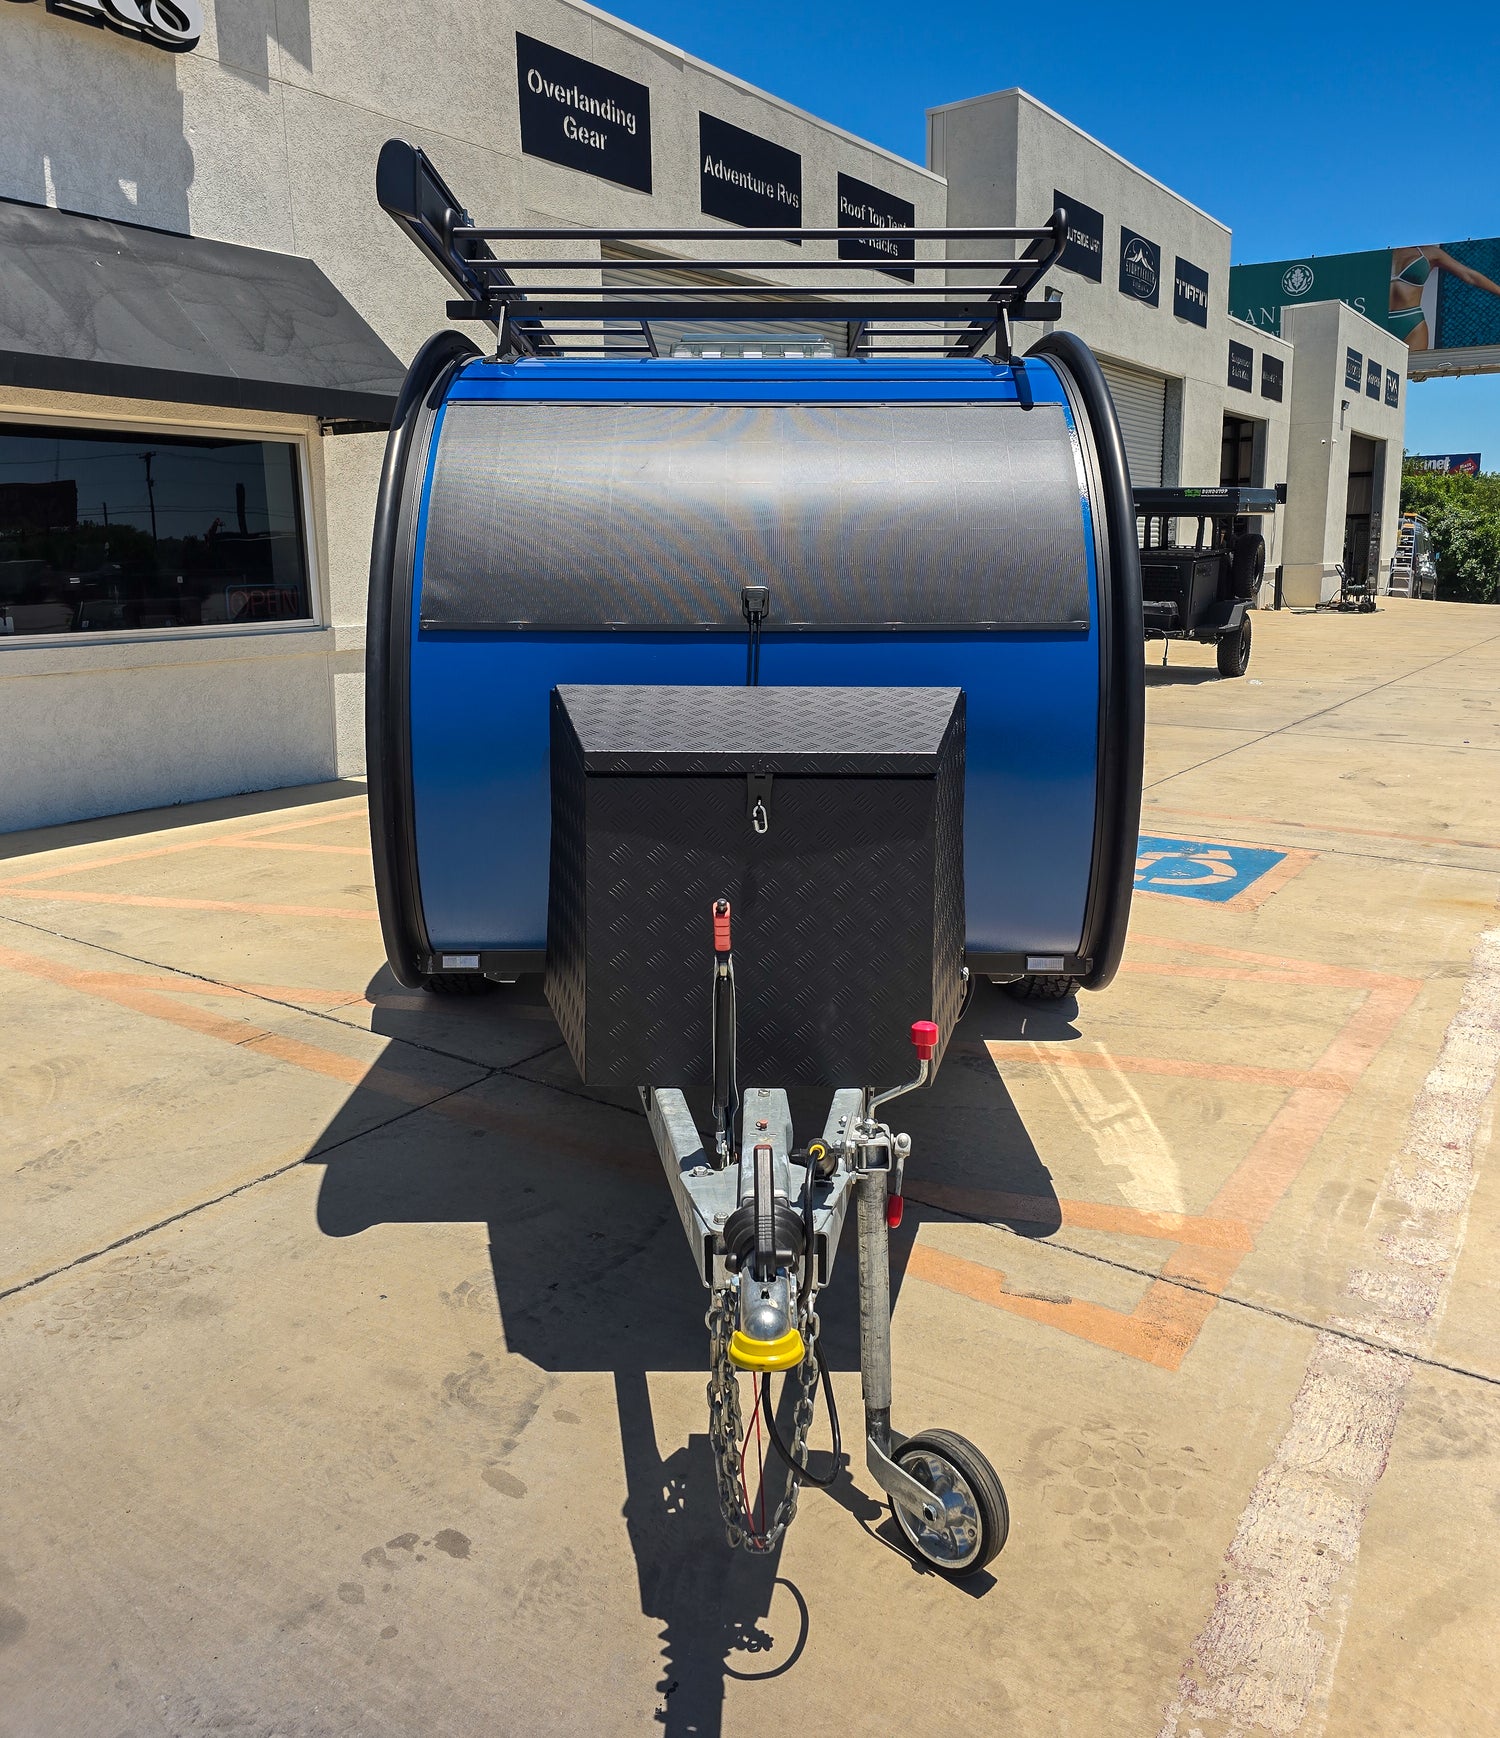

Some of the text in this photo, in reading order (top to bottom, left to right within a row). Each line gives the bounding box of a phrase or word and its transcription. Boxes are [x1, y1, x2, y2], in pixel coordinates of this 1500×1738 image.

[527, 68, 636, 136] Overlanding
[563, 115, 607, 151] Gear
[704, 154, 799, 209] Adventure Rvs
[840, 195, 866, 221] Roof
[868, 206, 885, 228] Top
[230, 589, 298, 616] OPEN
